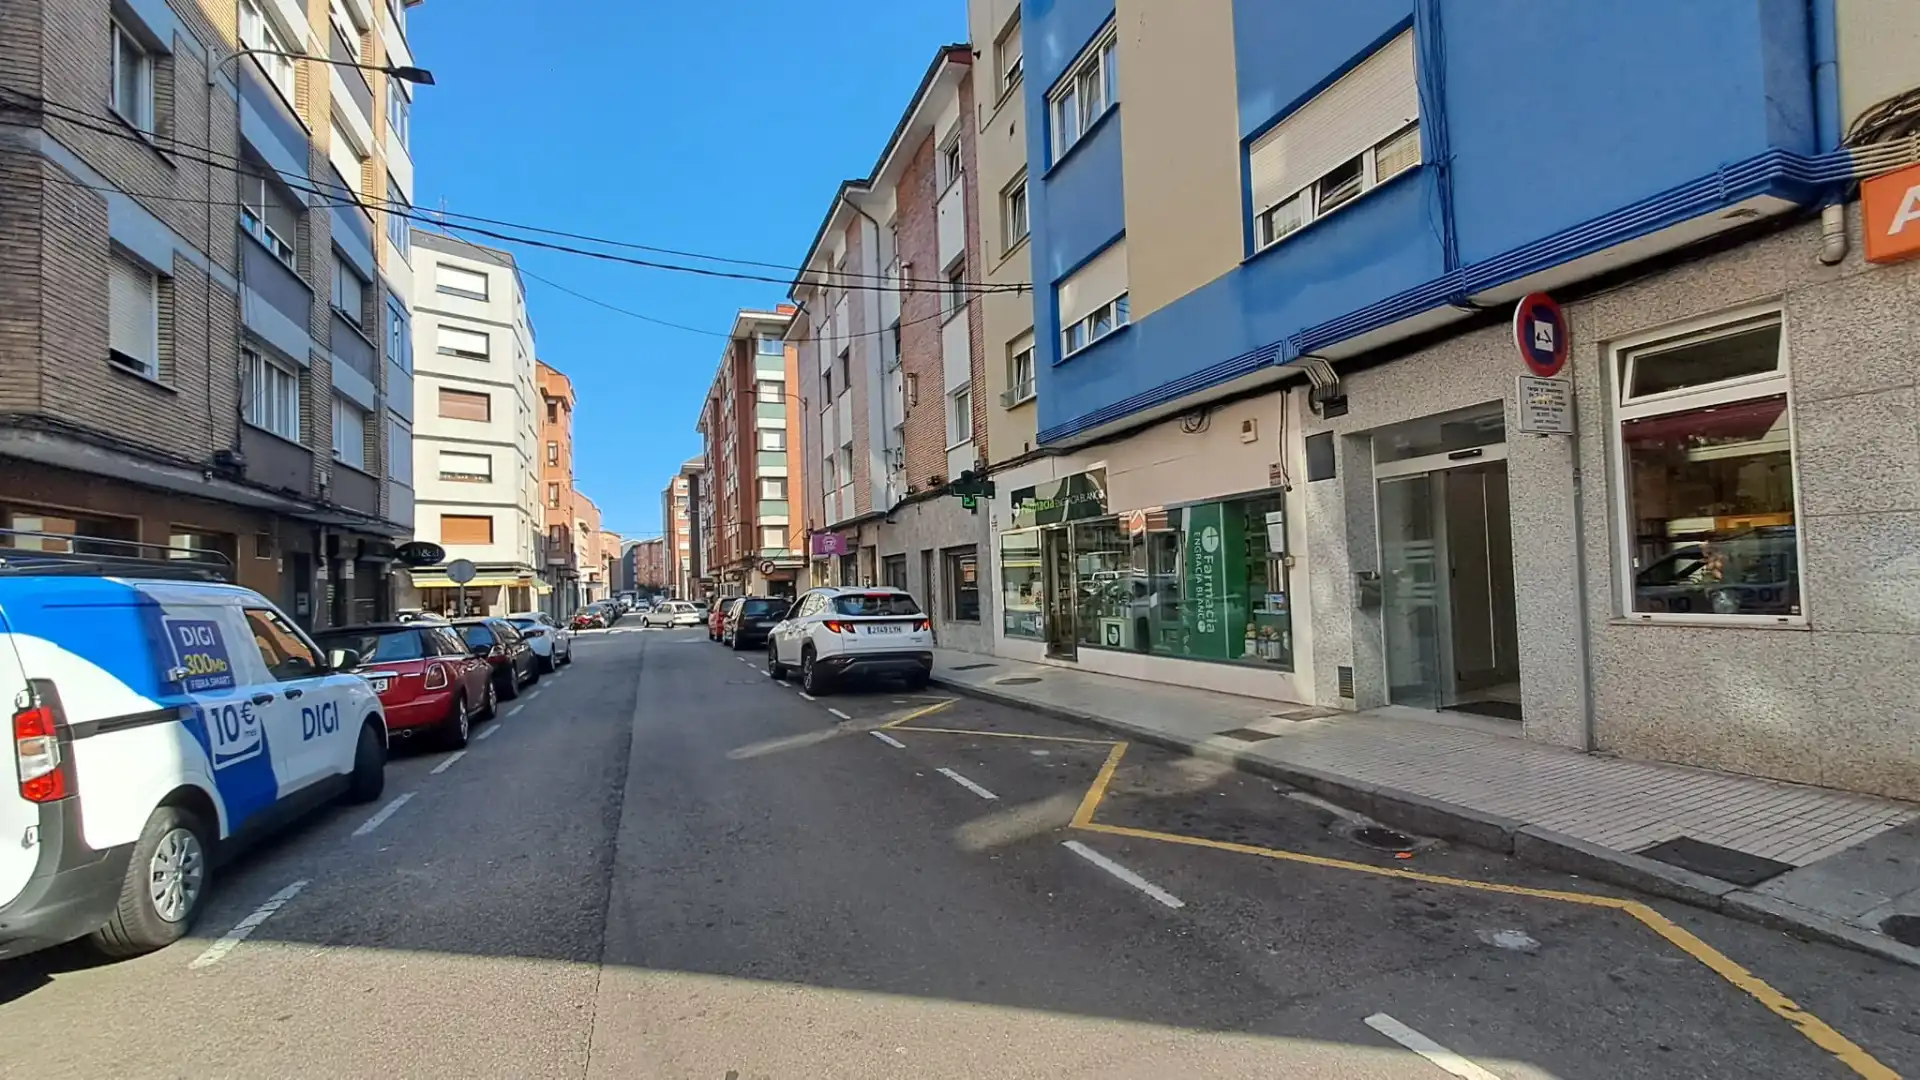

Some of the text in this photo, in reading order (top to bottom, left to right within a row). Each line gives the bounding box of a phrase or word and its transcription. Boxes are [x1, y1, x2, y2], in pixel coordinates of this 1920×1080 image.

[1193, 531, 1203, 584] ENGRACIA
[1203, 555, 1217, 633] Farmacia
[179, 626, 216, 647] DIGI
[209, 675, 232, 688] SMART
[301, 700, 340, 741] DIGI
